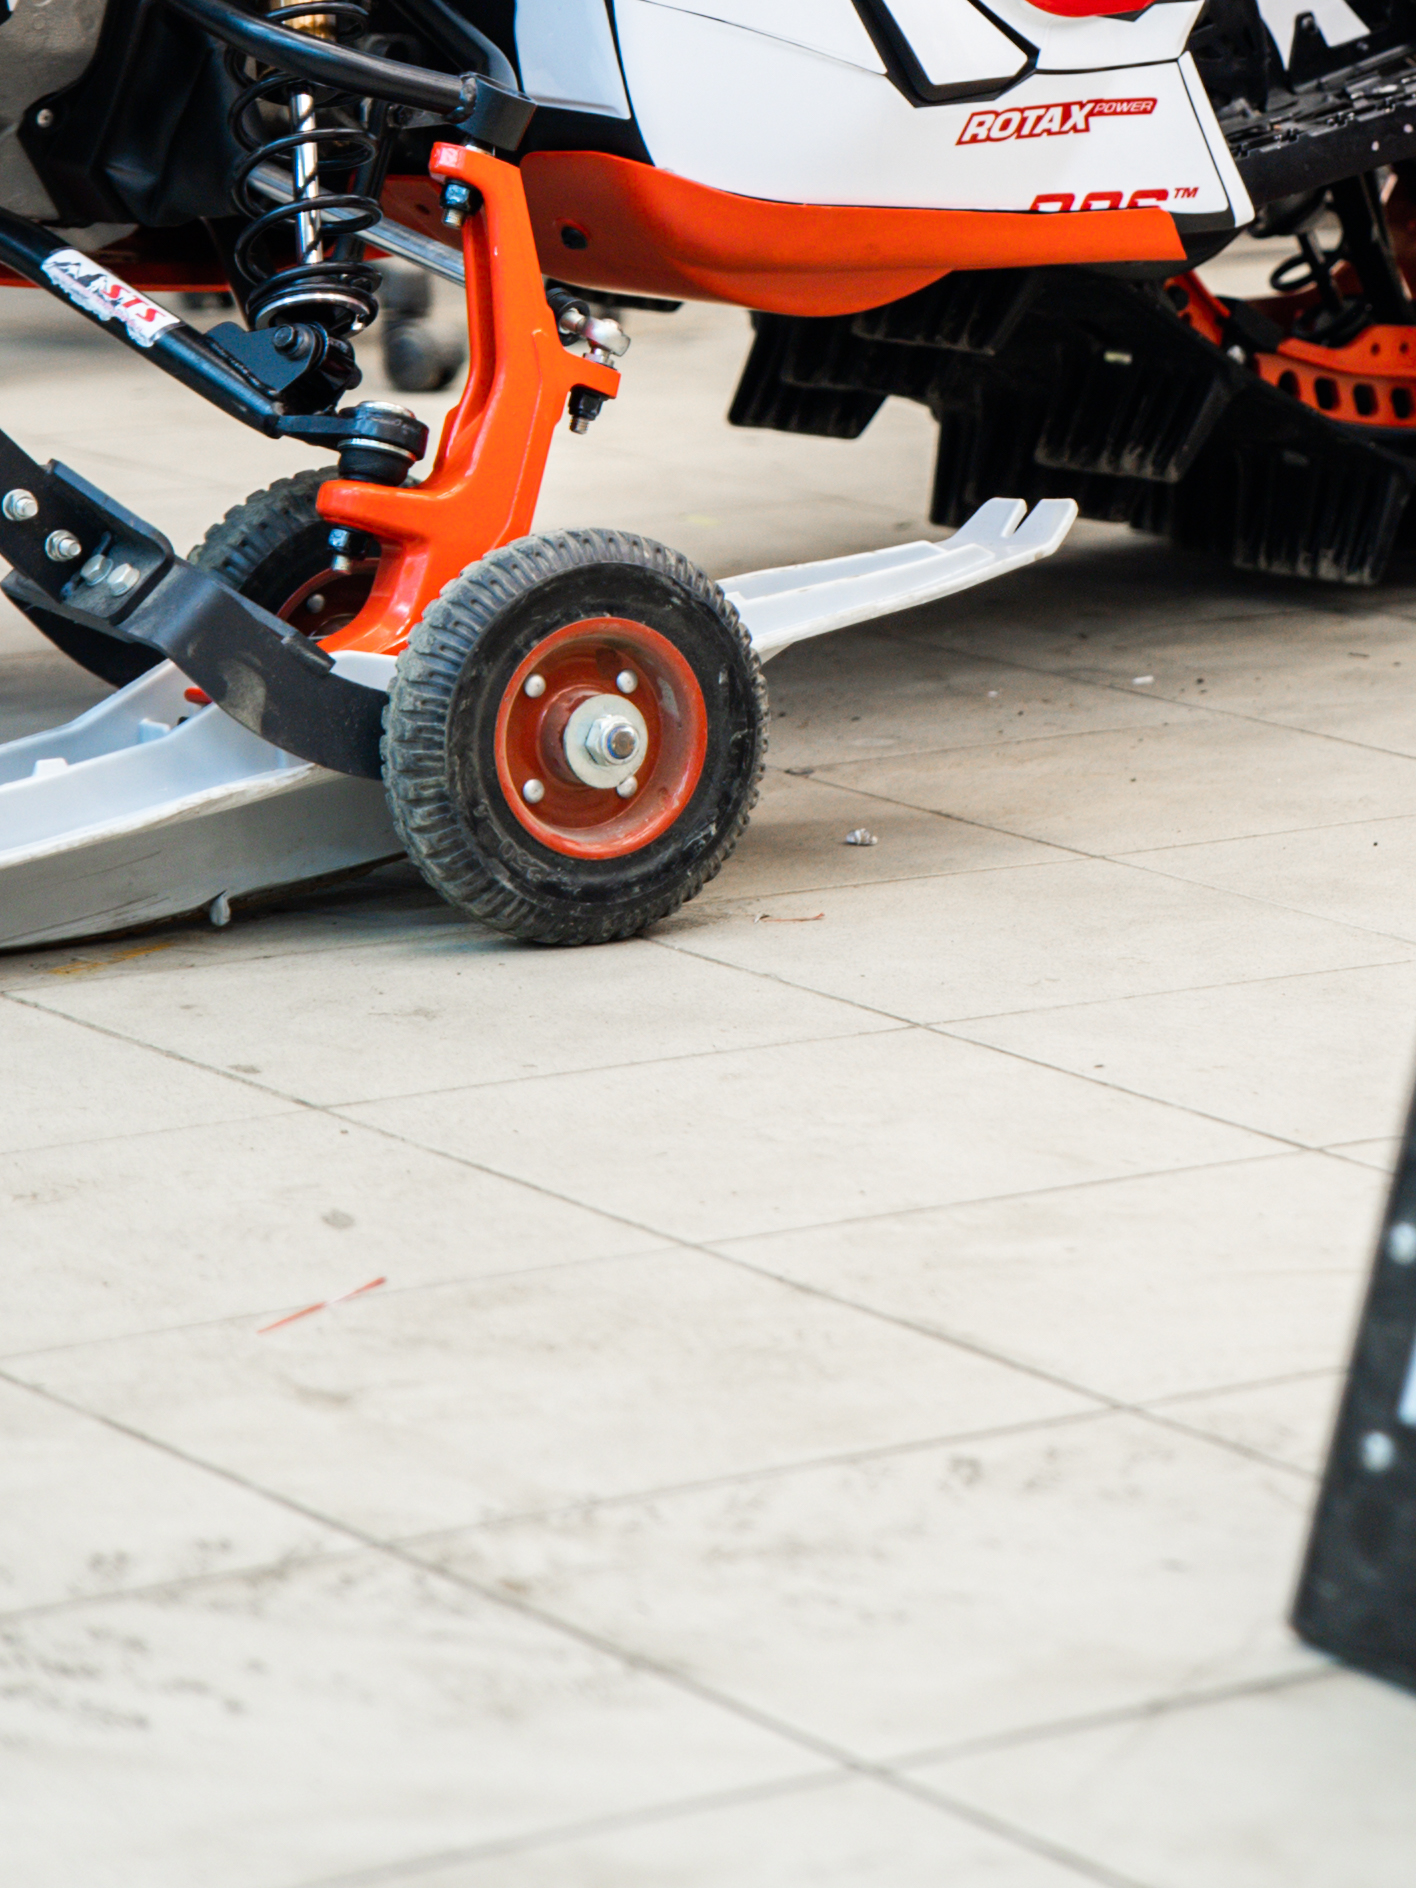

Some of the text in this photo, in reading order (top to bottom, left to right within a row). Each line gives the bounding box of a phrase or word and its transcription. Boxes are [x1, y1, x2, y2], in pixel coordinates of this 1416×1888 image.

[956, 99, 1155, 145] ROTAX POWER
[101, 283, 167, 323] STS
